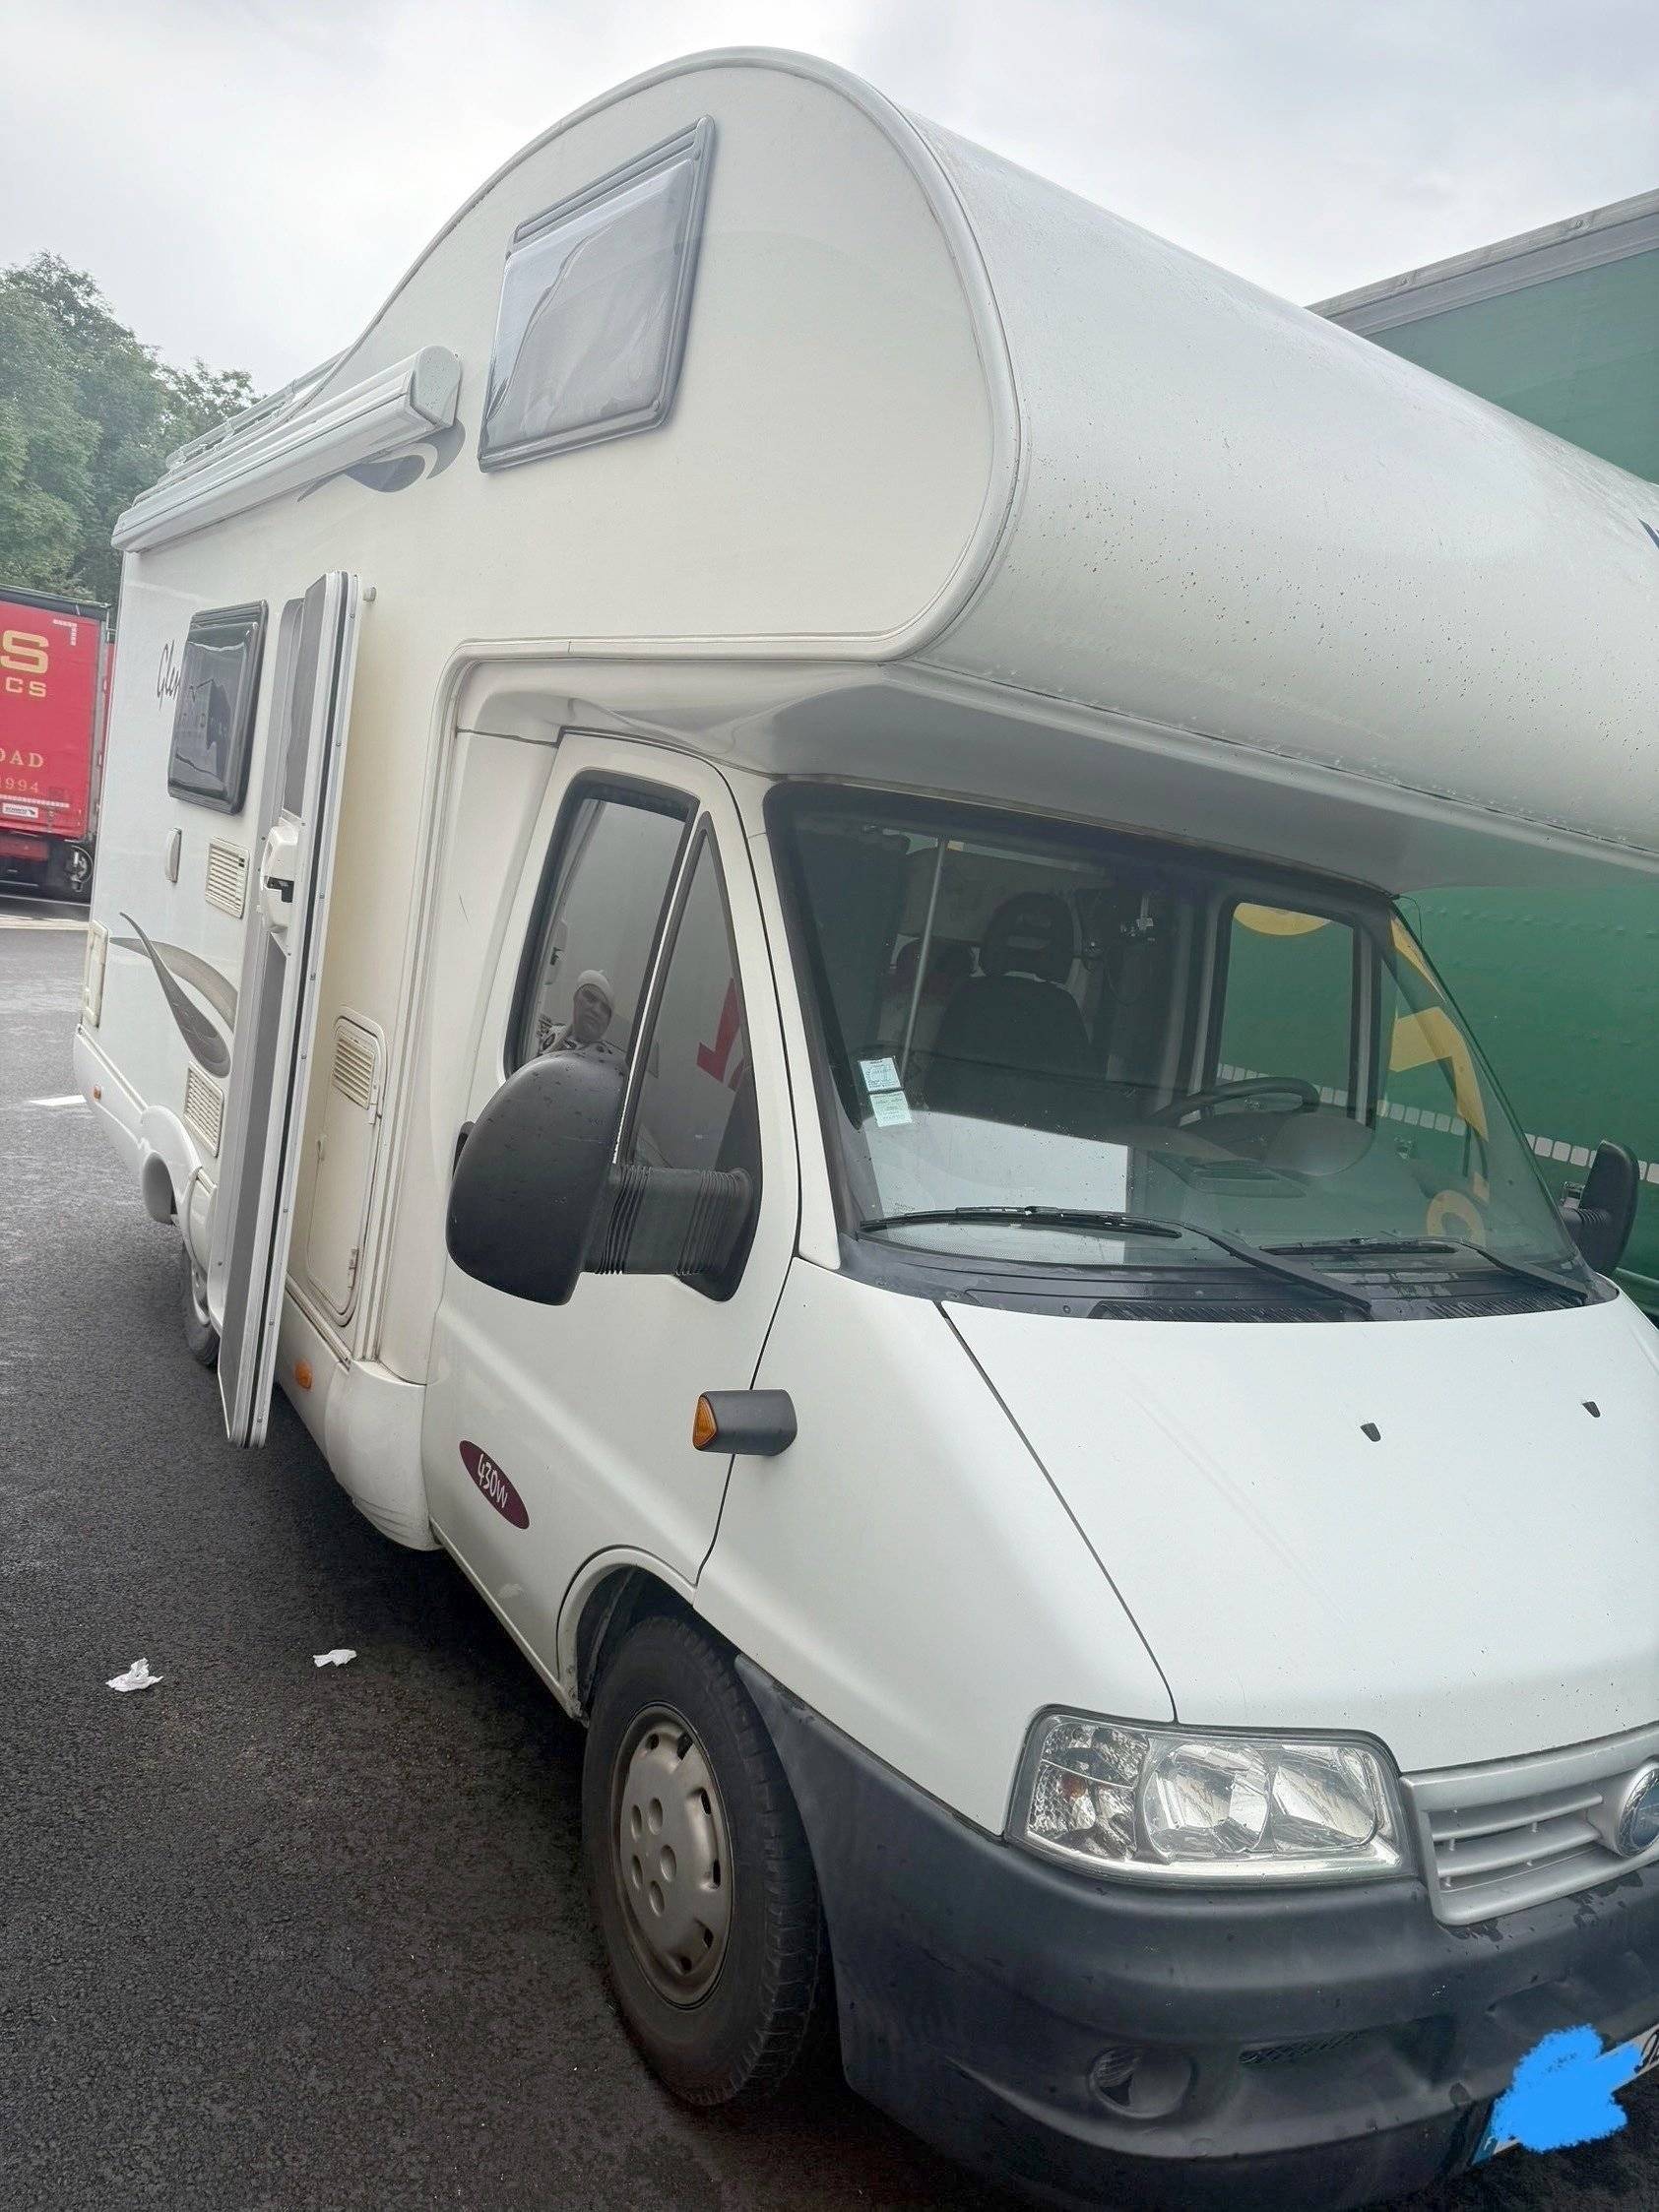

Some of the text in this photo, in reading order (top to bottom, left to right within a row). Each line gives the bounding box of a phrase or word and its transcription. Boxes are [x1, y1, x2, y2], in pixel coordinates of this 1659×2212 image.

[1, 630, 49, 673] S
[6, 676, 46, 697] CS
[0, 774, 38, 793] 994
